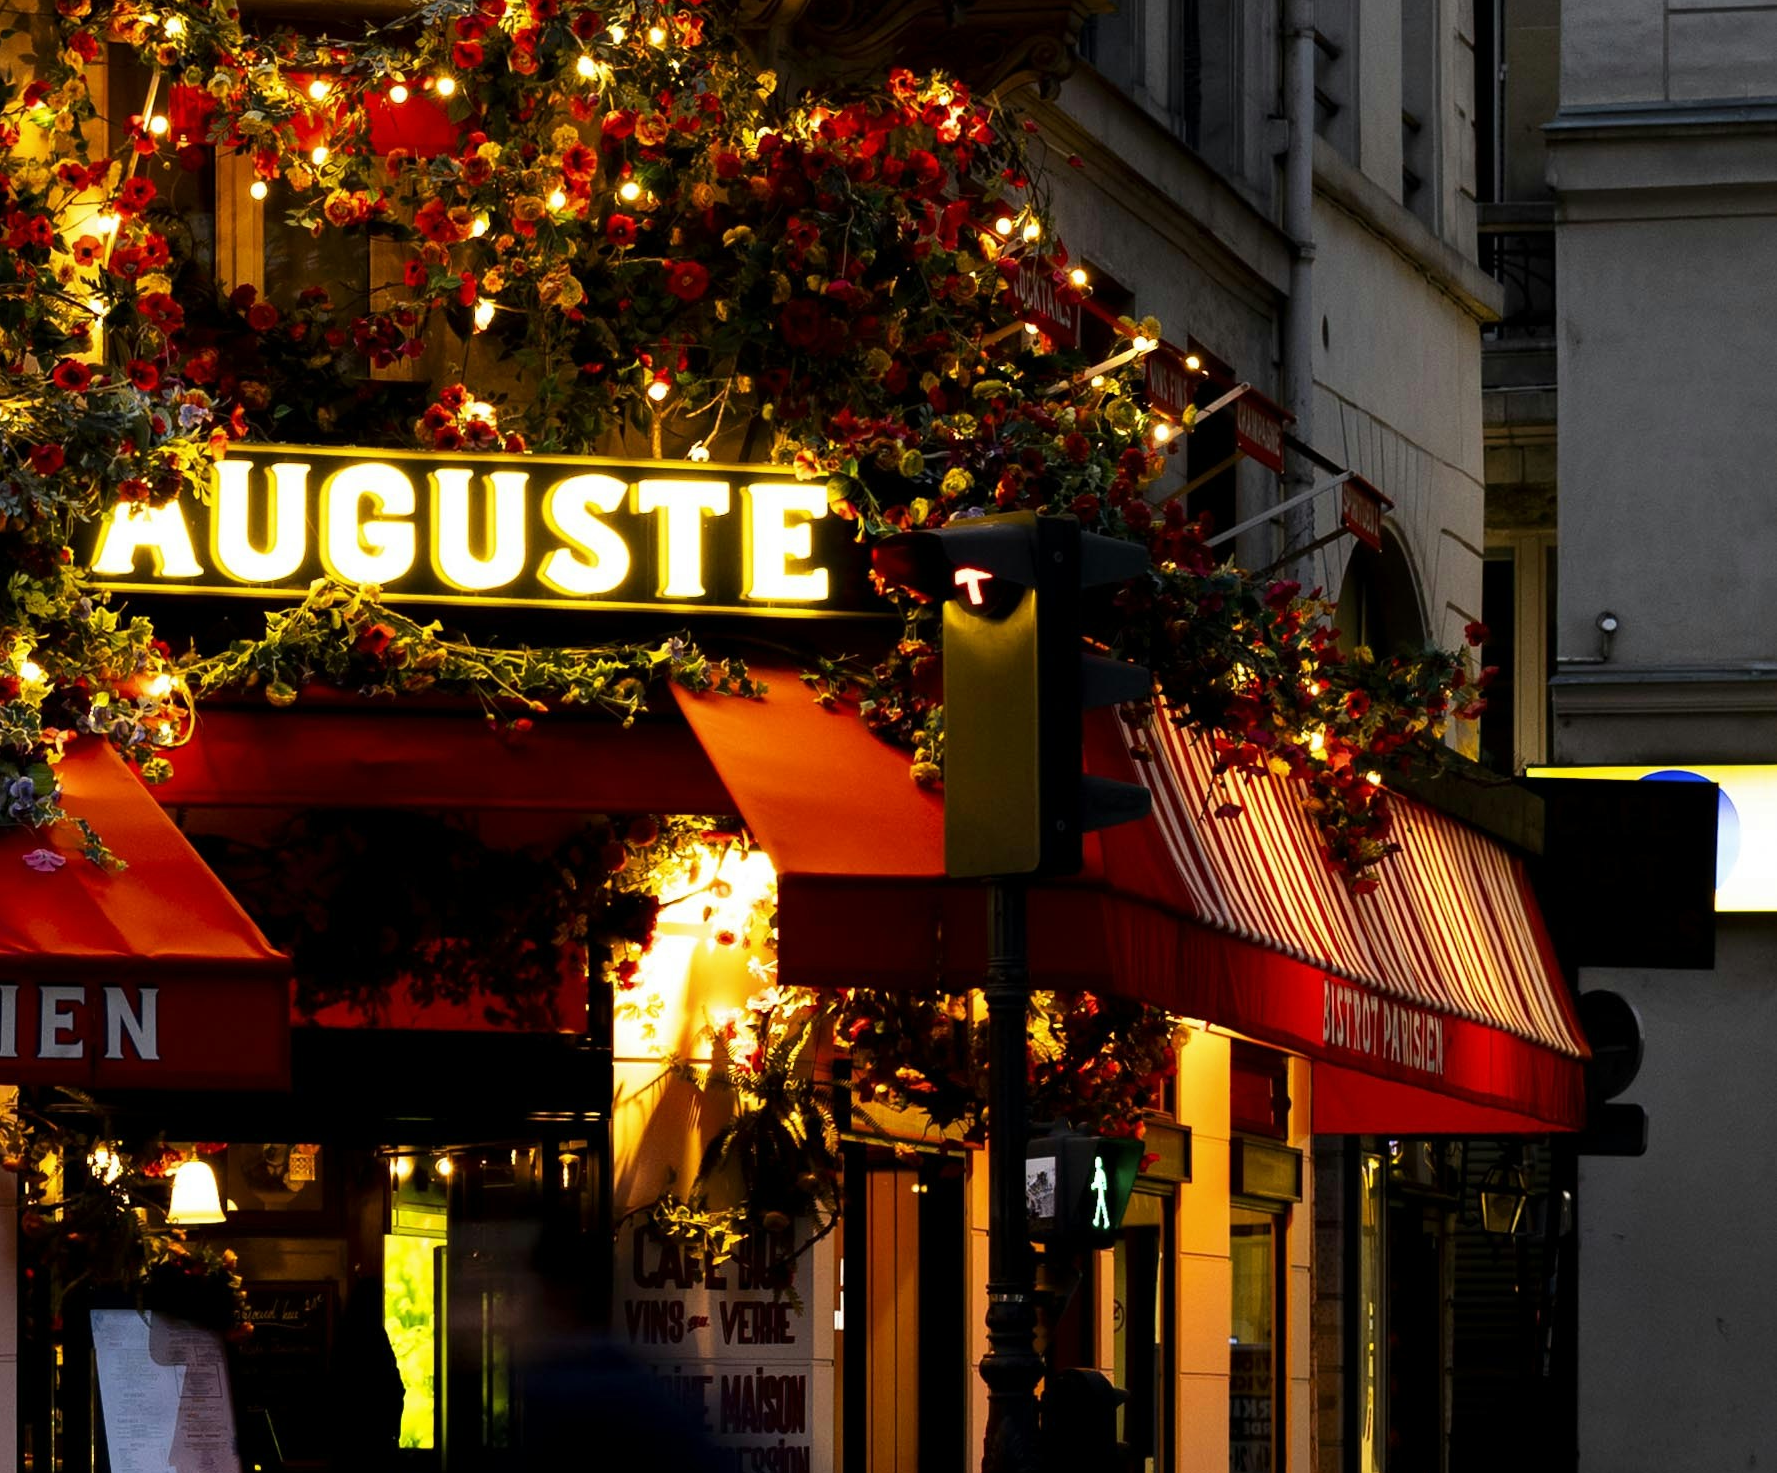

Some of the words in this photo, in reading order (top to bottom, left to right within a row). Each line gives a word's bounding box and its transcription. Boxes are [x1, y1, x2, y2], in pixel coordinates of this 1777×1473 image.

[92, 460, 830, 601] AUGUSTE
[1322, 979, 1380, 1058] BISTROT
[1382, 998, 1443, 1077] PARISIEN
[625, 1300, 684, 1343] VINS
[719, 1301, 795, 1344] VERRE
